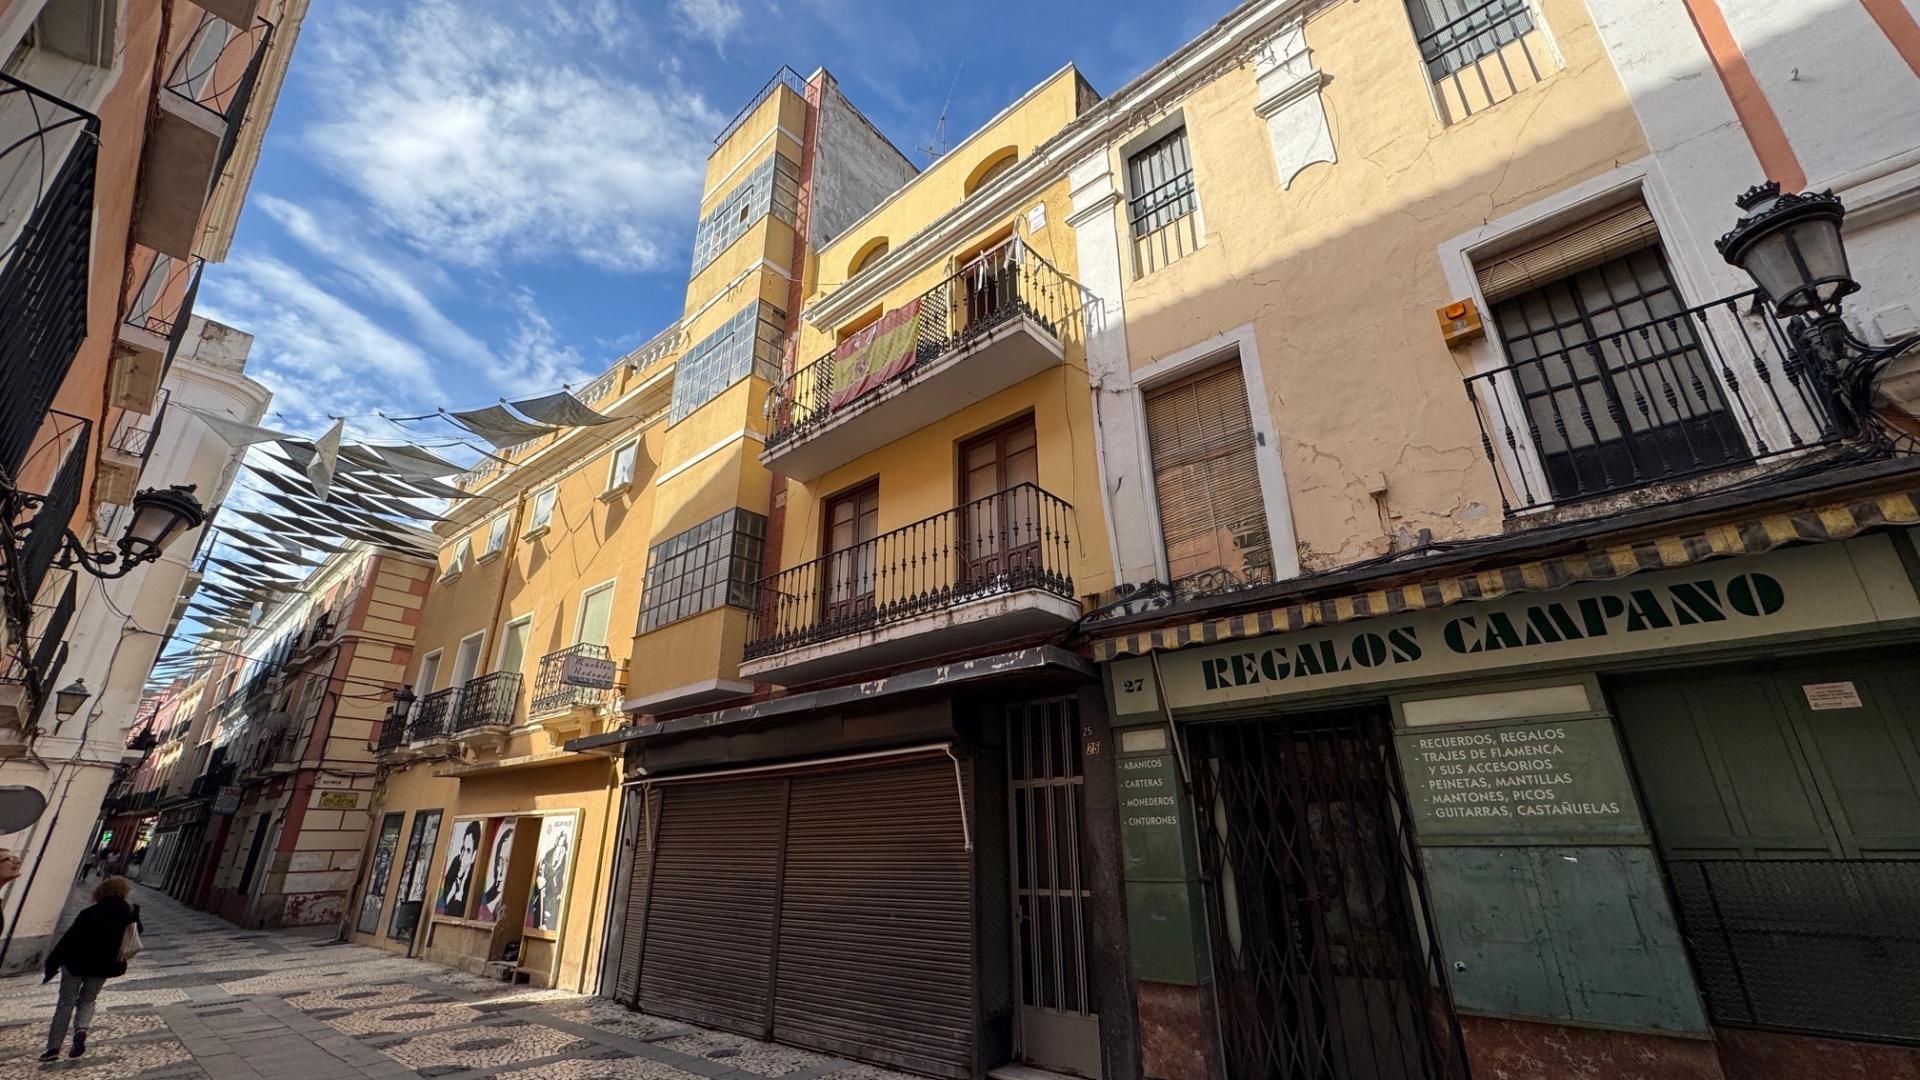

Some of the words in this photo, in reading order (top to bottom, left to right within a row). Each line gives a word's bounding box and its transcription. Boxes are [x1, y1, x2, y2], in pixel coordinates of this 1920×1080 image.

[1202, 625, 1422, 691] REGALOS
[1443, 572, 1785, 654] CAMPANO
[1124, 678, 1144, 693] 27
[1082, 726, 1093, 737] 25
[1419, 733, 1497, 750] RECUERDOS,
[1500, 728, 1565, 743] REGALOS
[1087, 741, 1100, 754] 25
[1422, 751, 1467, 763] TRAJES
[1471, 748, 1486, 759] DE
[1491, 744, 1564, 758] FLAMENCA
[1124, 759, 1162, 770] ABANICOS
[1428, 766, 1436, 776] Y
[1440, 764, 1463, 775] SUS
[1467, 759, 1553, 774] ACCESORIOS
[1125, 778, 1163, 788] CARTERAS
[1429, 777, 1491, 790] PEINETAS,
[1495, 773, 1573, 787] MANTILLAS
[1126, 796, 1174, 807] MONEDEROS
[1432, 790, 1509, 804] MANTONES,
[1512, 788, 1555, 801] PICOS
[1435, 805, 1513, 818] GUITARRAS,
[1516, 801, 1620, 816] CASTAÑUELAS
[1128, 815, 1176, 826] CINTURONES
